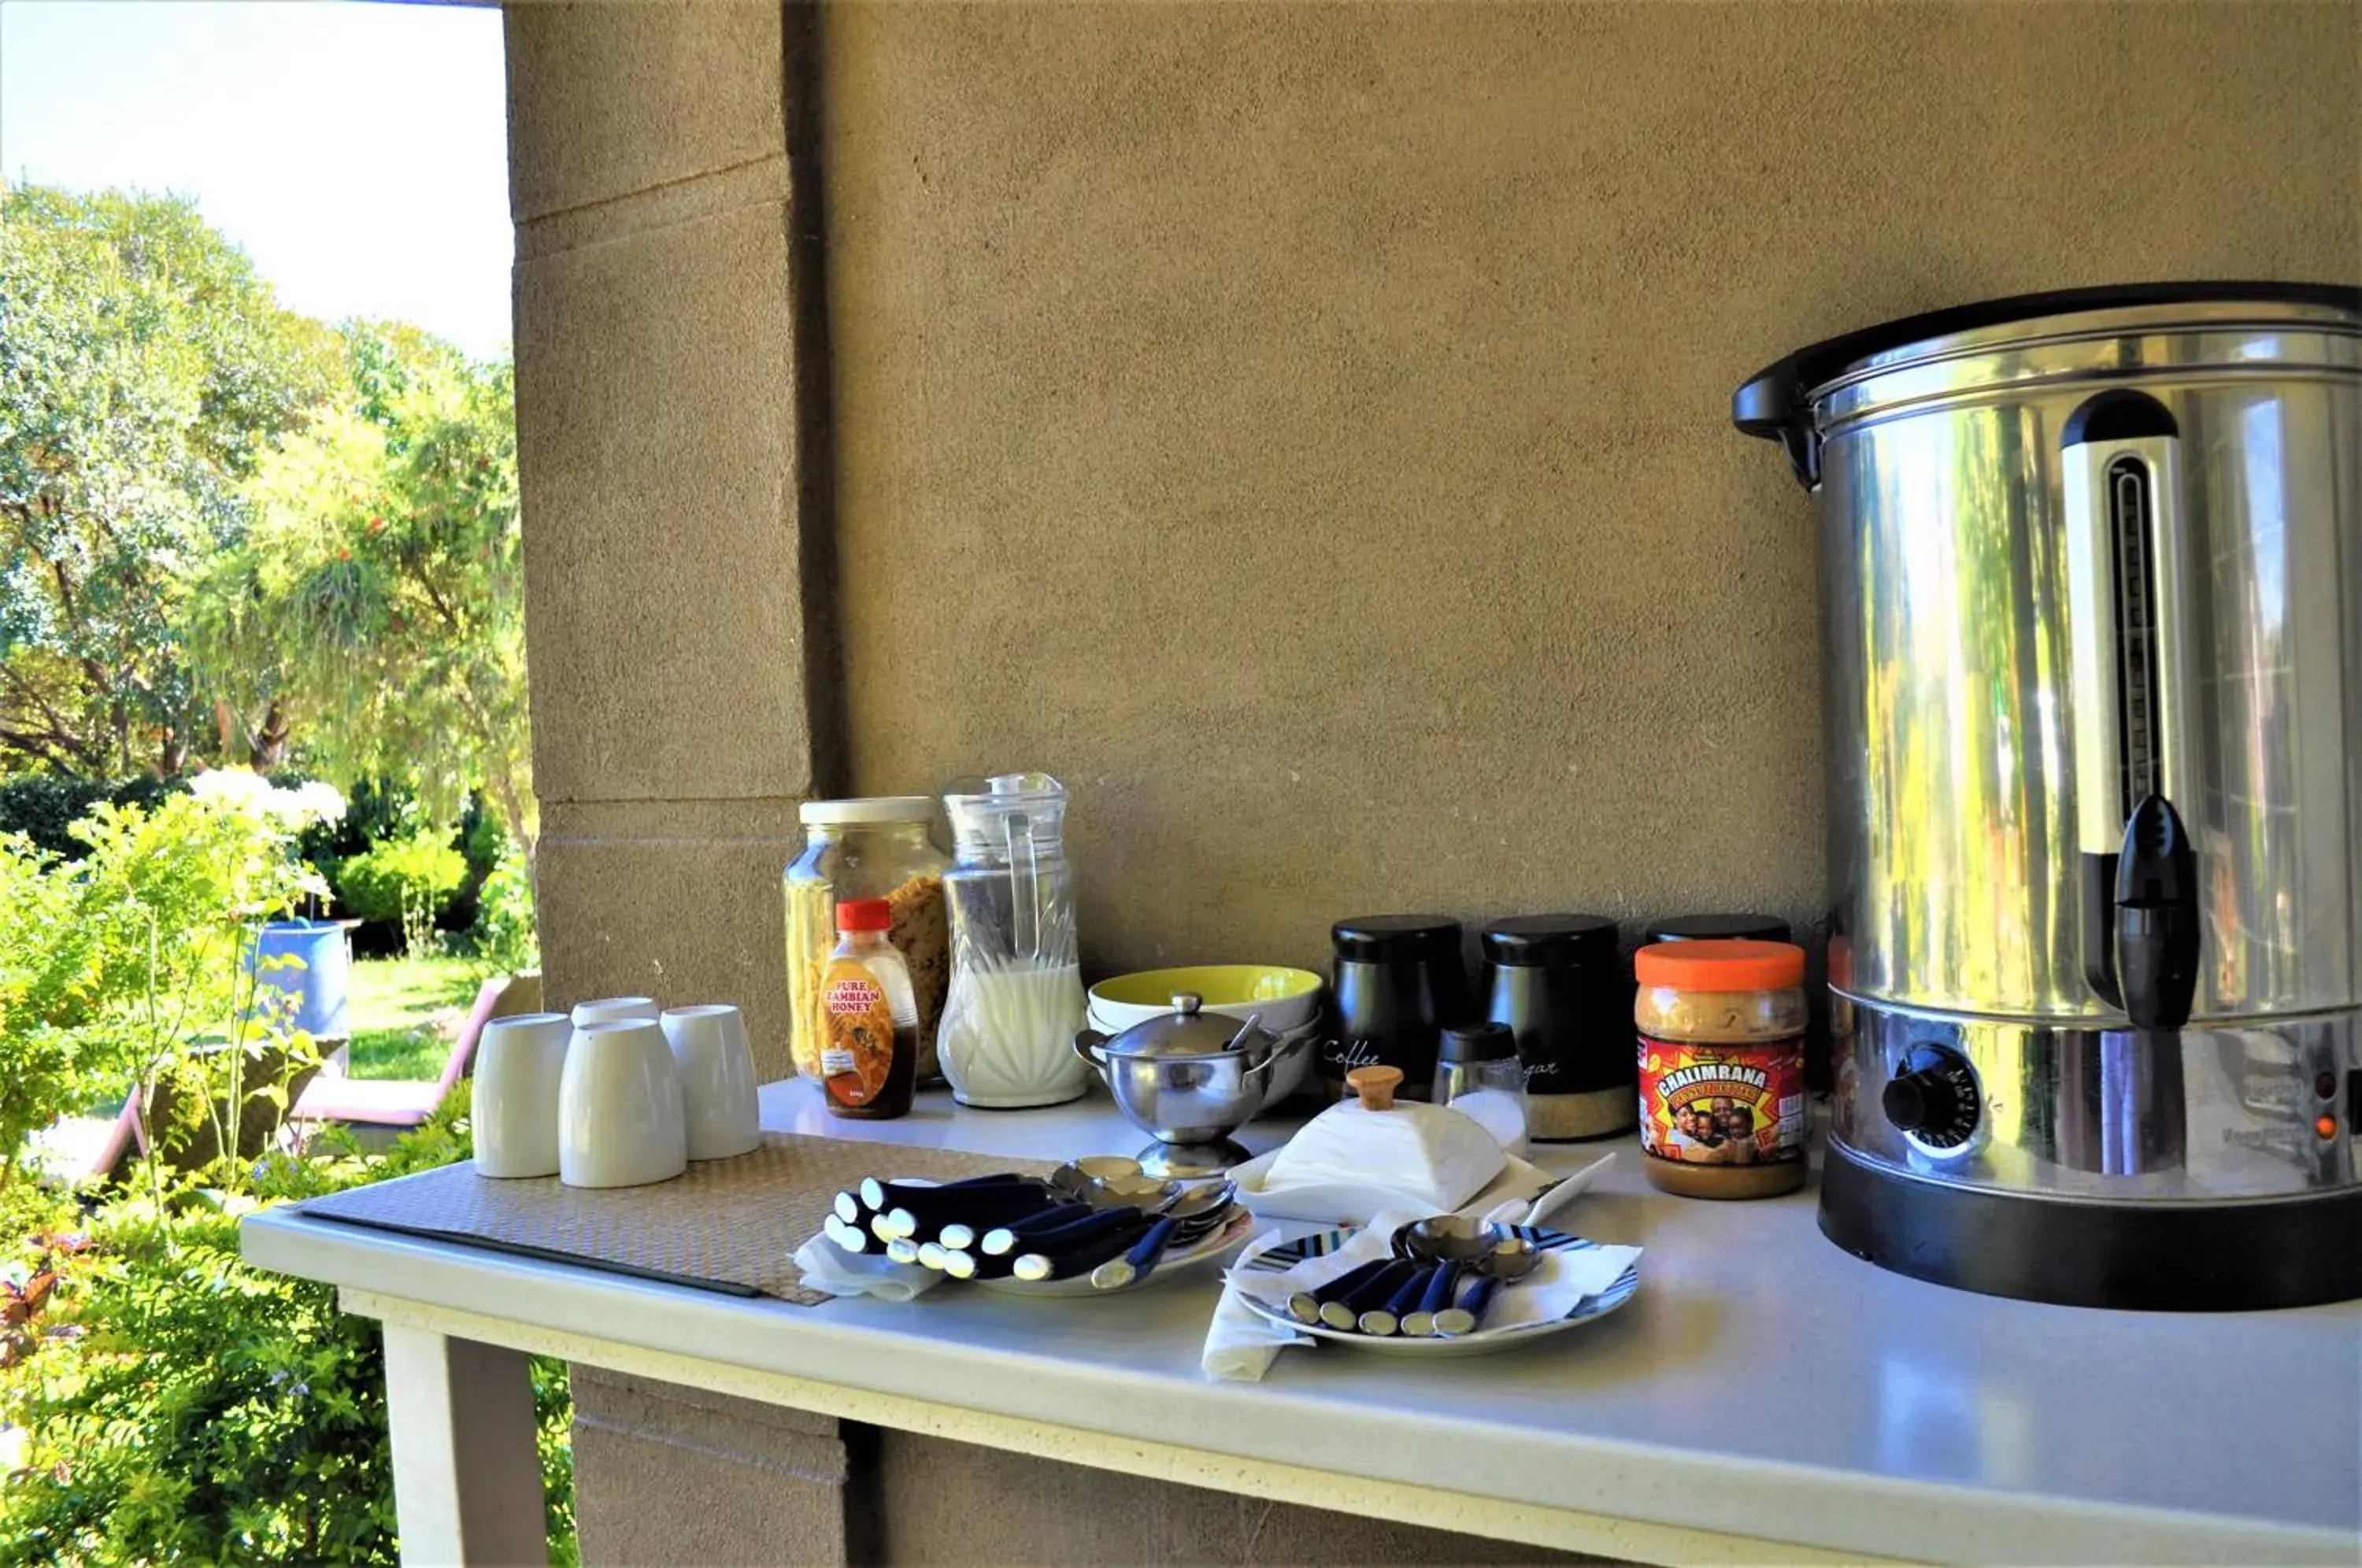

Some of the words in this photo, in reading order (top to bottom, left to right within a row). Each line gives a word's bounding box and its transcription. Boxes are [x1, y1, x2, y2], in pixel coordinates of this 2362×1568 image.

[837, 982, 866, 990] PURE
[827, 991, 879, 1001] ZAMBIAN
[832, 1002, 872, 1011] HONEY
[1322, 1038, 1379, 1074] Coffee
[1658, 1064, 1766, 1097] CHALIMBANA
